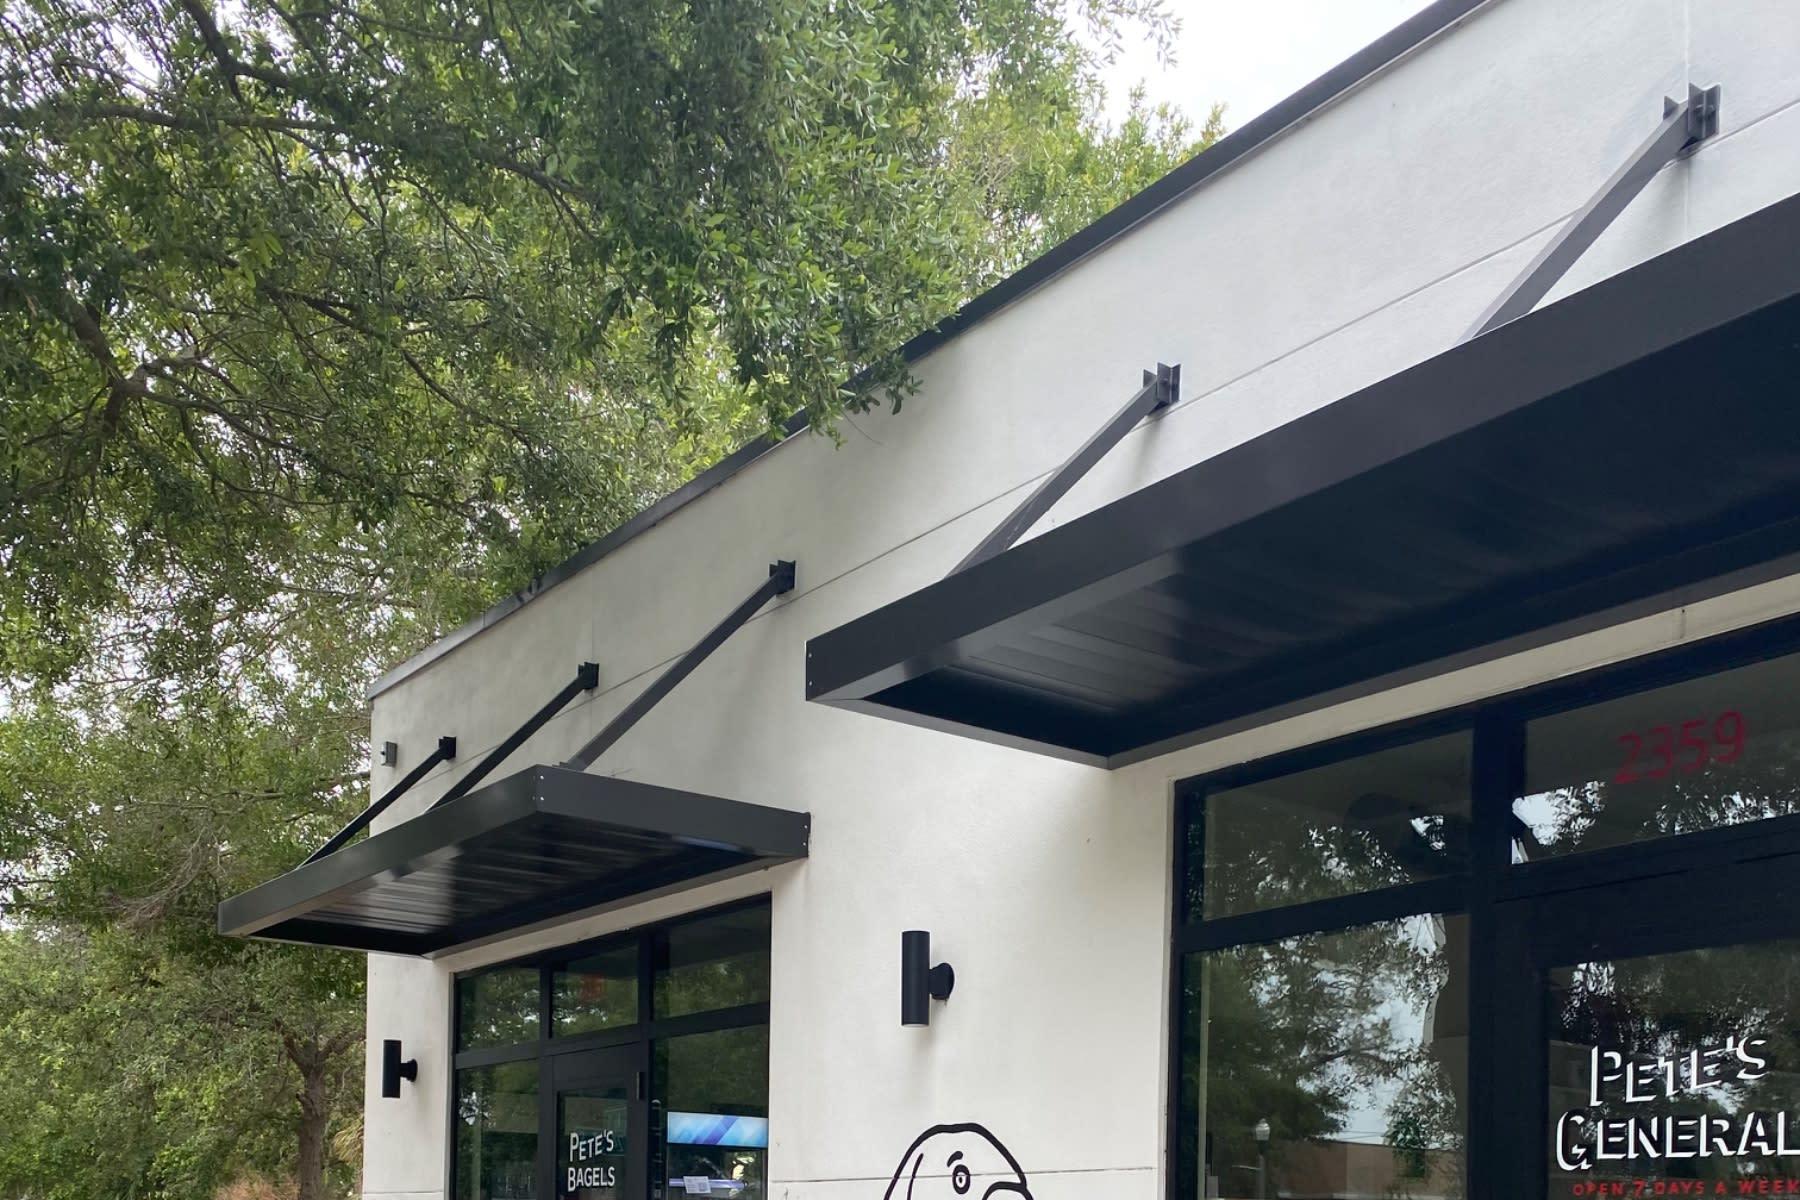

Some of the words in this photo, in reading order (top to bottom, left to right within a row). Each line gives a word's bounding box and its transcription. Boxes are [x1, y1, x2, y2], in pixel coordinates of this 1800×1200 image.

[1613, 709, 1746, 784] 2359
[1589, 1035, 1769, 1107] PETE'S
[569, 1129, 614, 1162] PETE'S
[1556, 1110, 1800, 1171] GENERAL
[567, 1166, 616, 1192] BAGELS
[1573, 1182, 1624, 1197] OPEN
[1632, 1179, 1646, 1199] 7
[1655, 1181, 1705, 1196] DAYS
[1714, 1181, 1728, 1196] A
[1738, 1179, 1800, 1196] WEEK
